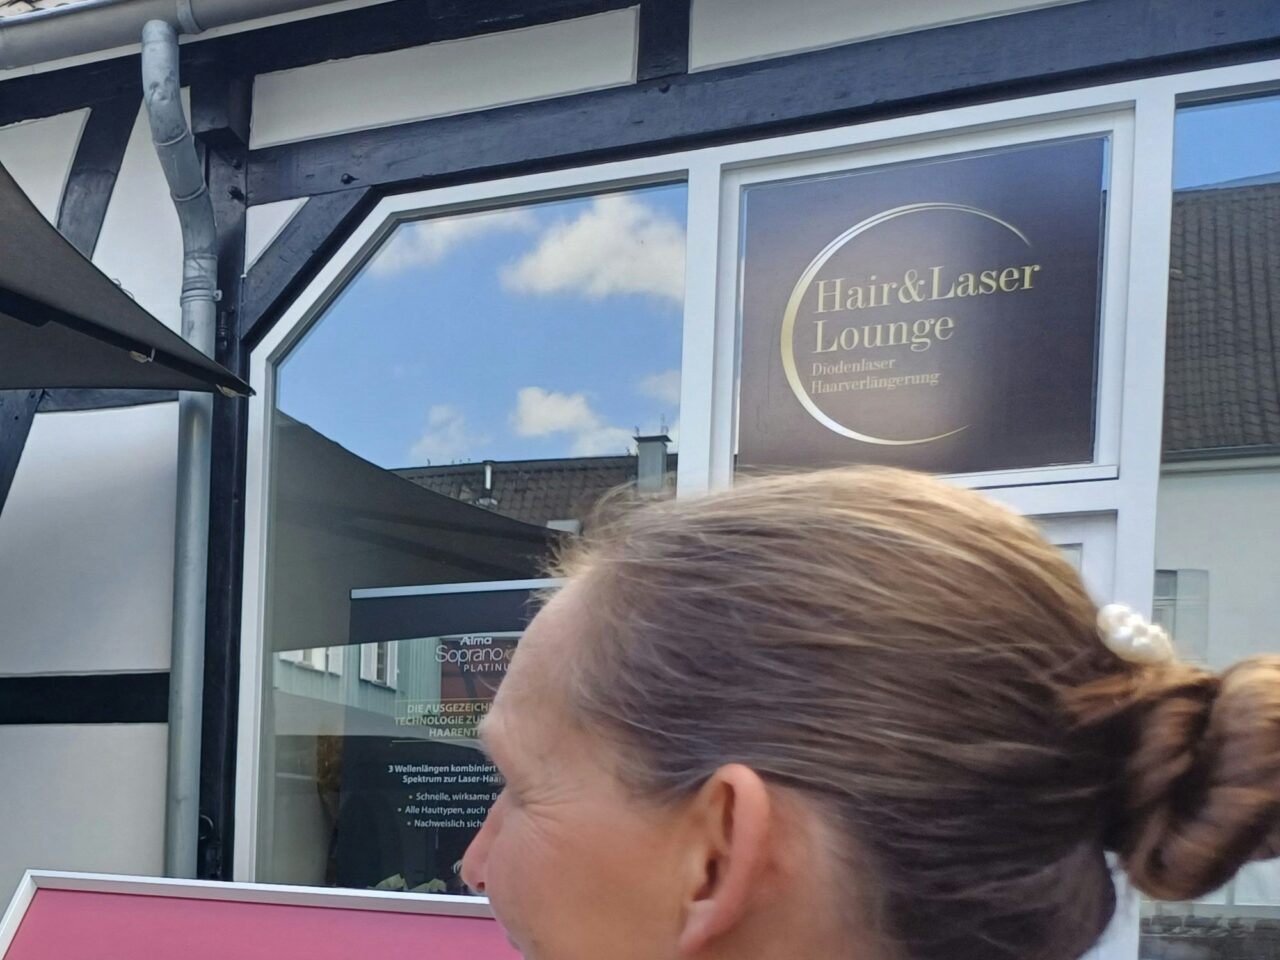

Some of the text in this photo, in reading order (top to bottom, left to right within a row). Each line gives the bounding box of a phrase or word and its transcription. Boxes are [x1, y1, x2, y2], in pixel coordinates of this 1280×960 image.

[813, 263, 1041, 314] Hair&Laser
[812, 315, 954, 353] Lounge
[812, 358, 896, 376] Diodenlaser
[811, 372, 941, 394] Haarverlängerung
[460, 636, 492, 646] Alma
[464, 663, 510, 672] PLATINU
[407, 703, 491, 713] DIE AUSGEZEICH
[395, 716, 465, 726] TECHNOLOGIE
[429, 728, 480, 738] HAARENT
[388, 764, 496, 774] 3 Wellenlängen kombiniert
[402, 775, 442, 784] Spektrum
[458, 774, 503, 783] Laser-Haa
[416, 792, 451, 801] Schnelle,
[452, 792, 490, 801] wirksame
[405, 806, 420, 814] Alle
[421, 806, 465, 815] Hauttypen,
[466, 806, 486, 814] auch
[414, 819, 484, 828] Nachweislich sich
